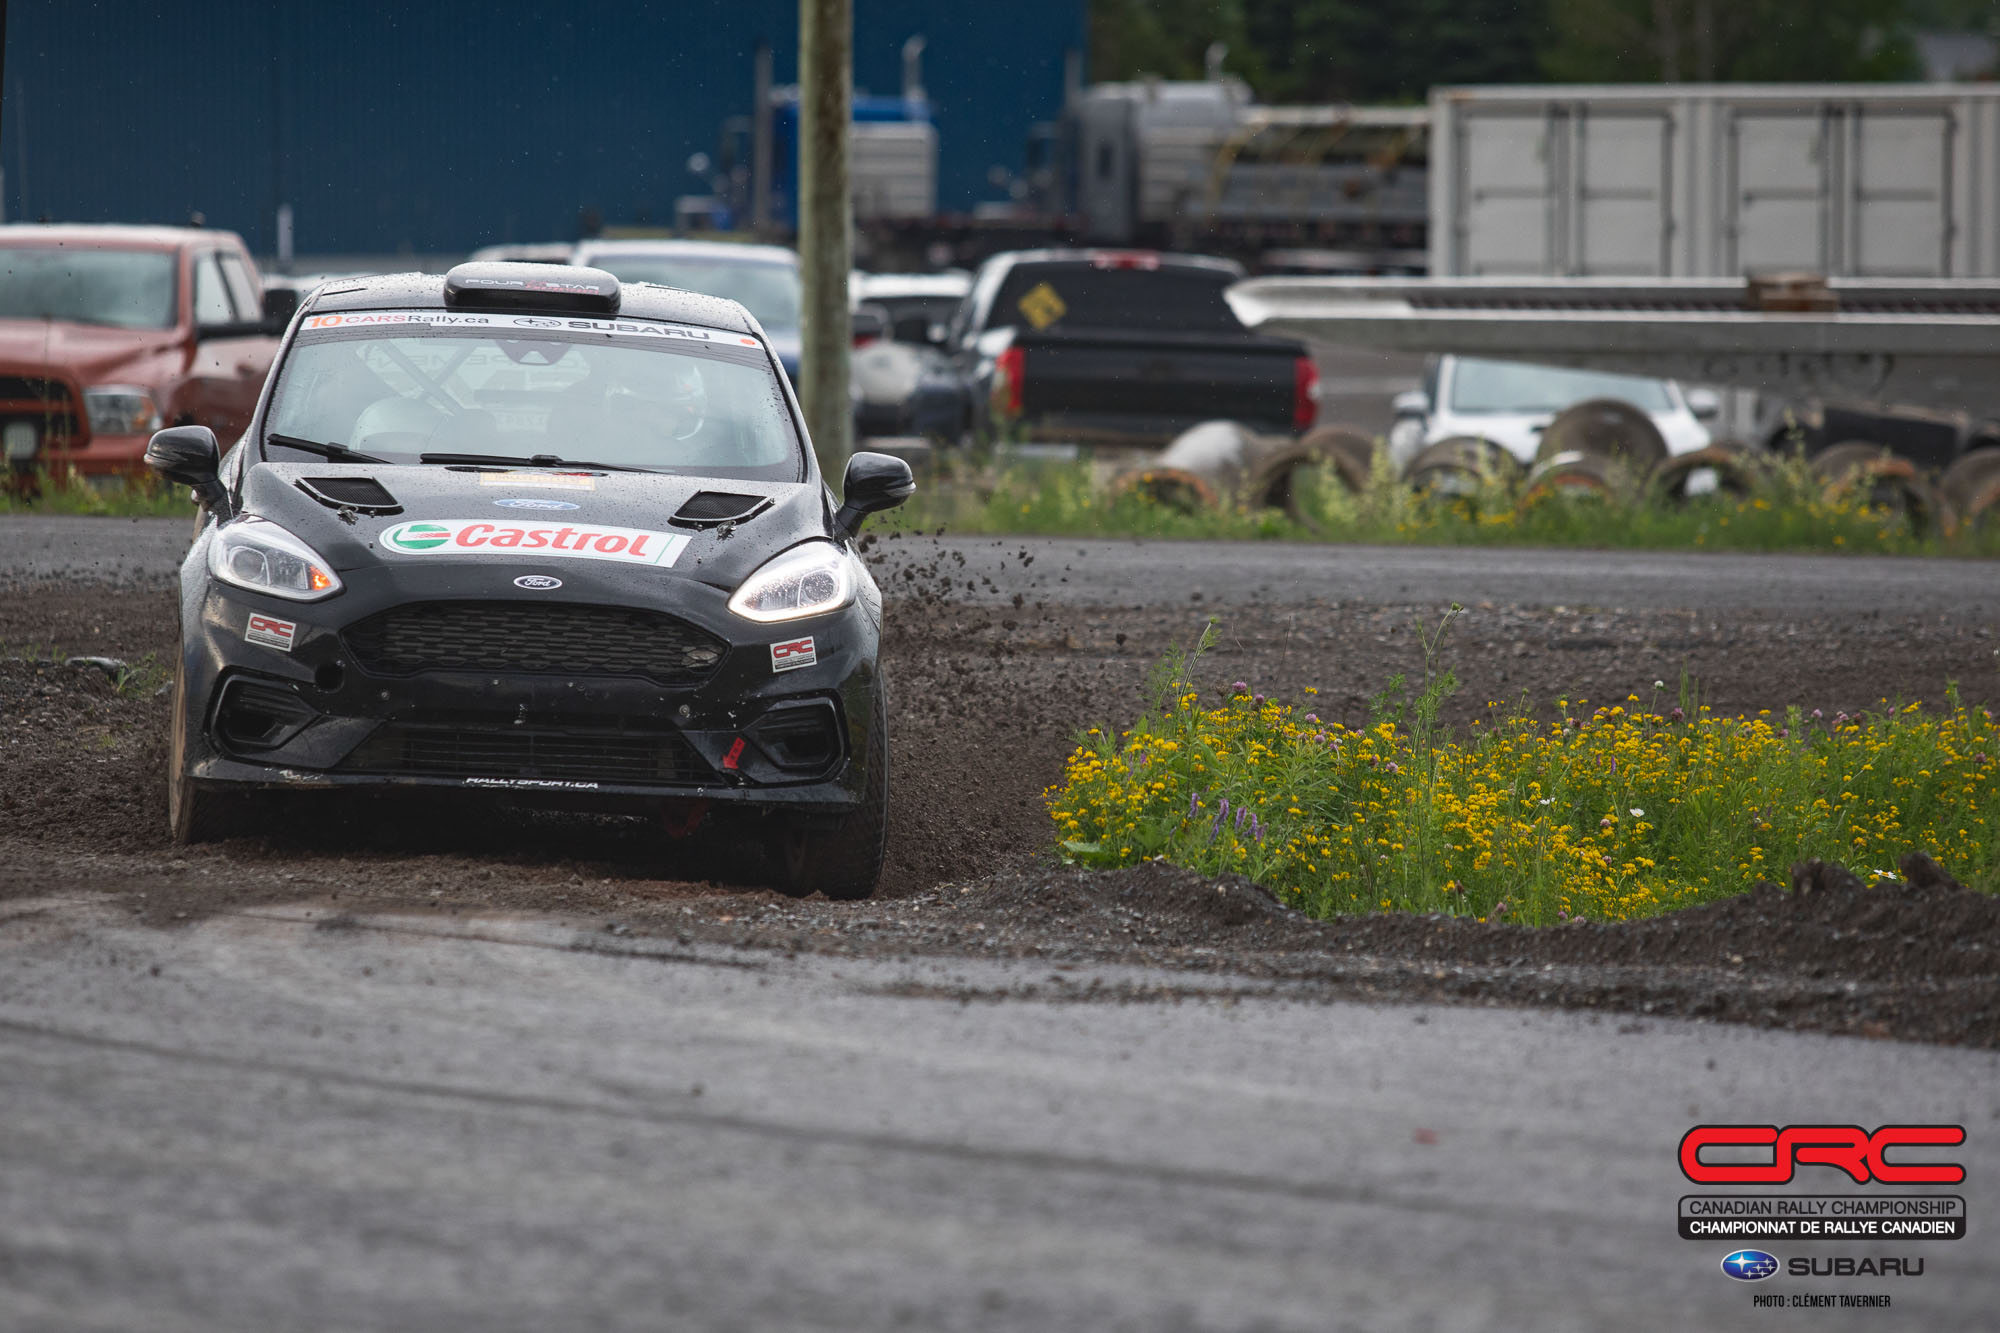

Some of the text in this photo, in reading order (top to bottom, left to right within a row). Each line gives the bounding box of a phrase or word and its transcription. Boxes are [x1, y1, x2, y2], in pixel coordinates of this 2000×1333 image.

[465, 278, 600, 290] FOUR STAR
[567, 320, 710, 340] SUBARU
[455, 523, 651, 557] Castrol
[523, 576, 551, 588] Ford
[250, 616, 293, 637] CRC
[773, 639, 814, 658] CRC
